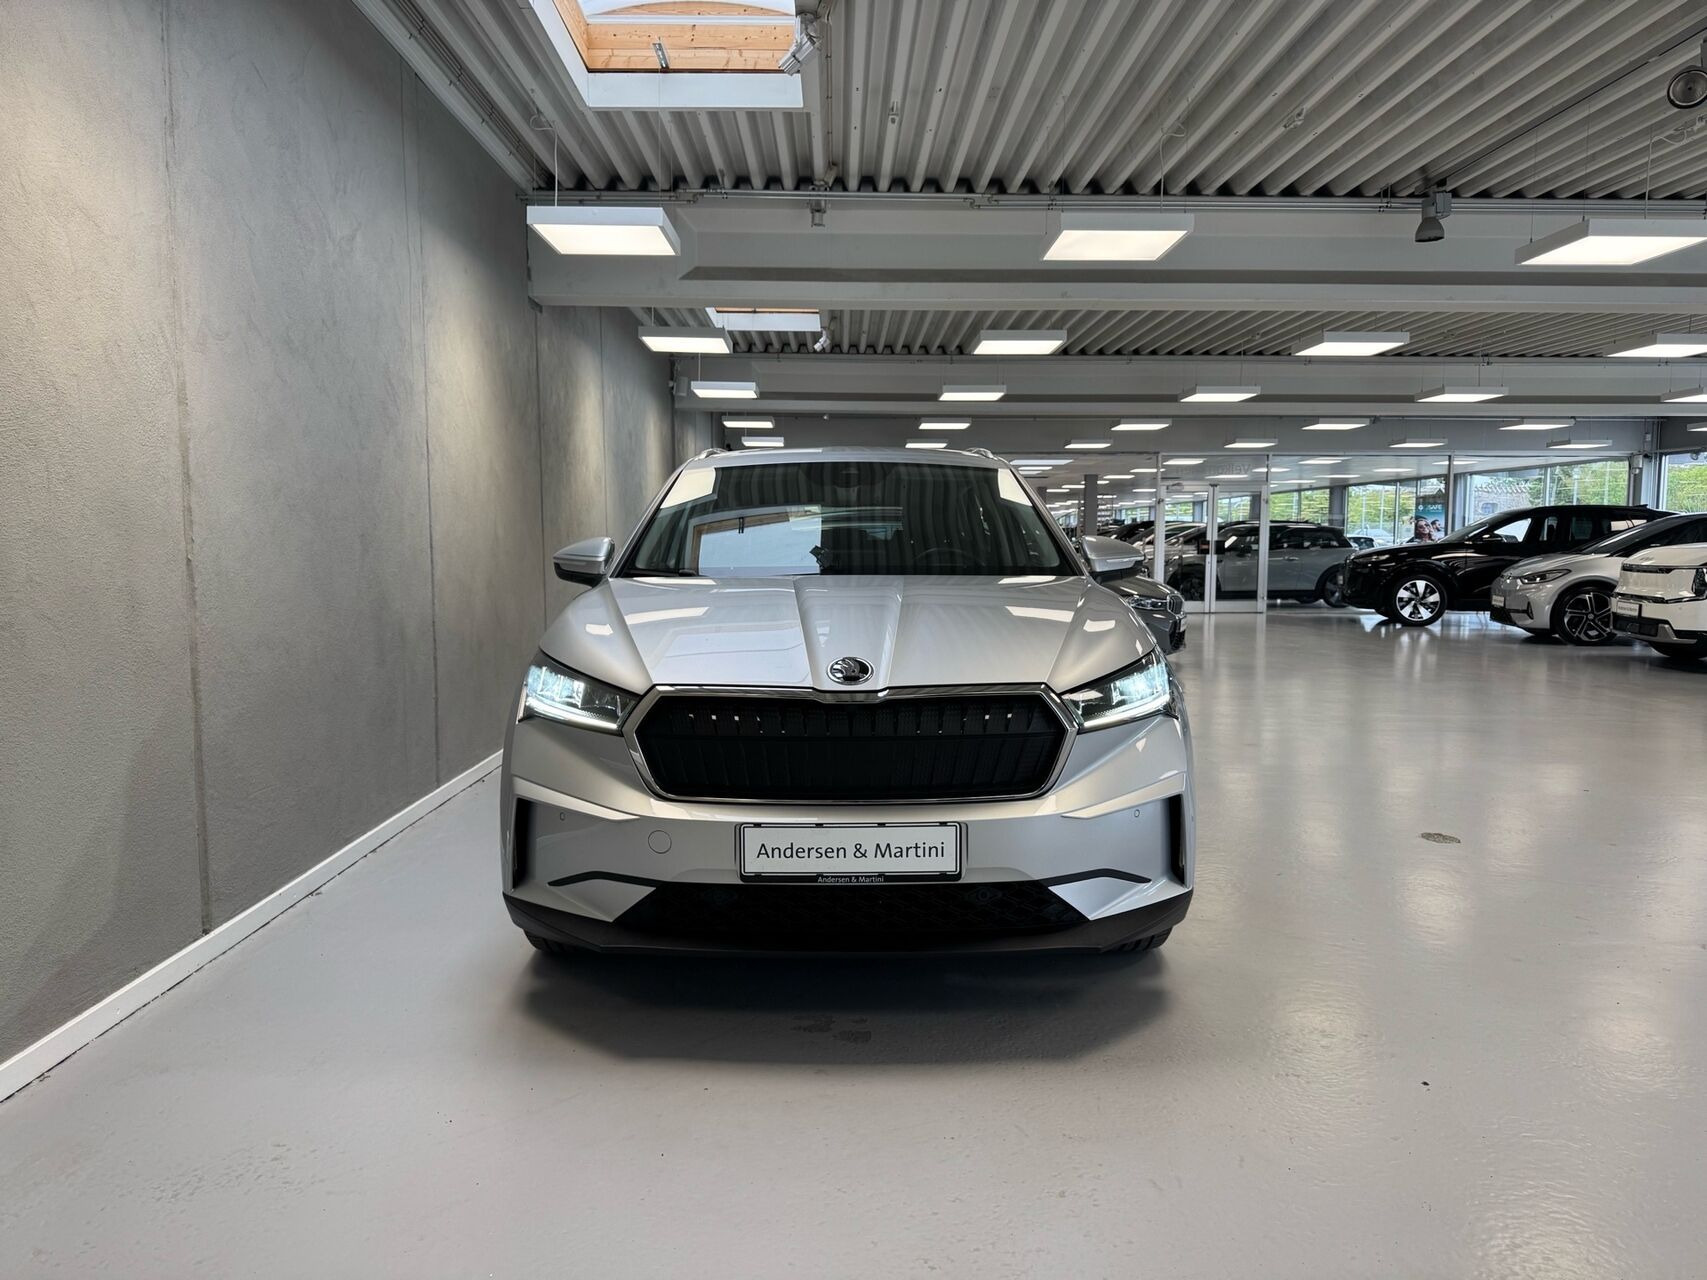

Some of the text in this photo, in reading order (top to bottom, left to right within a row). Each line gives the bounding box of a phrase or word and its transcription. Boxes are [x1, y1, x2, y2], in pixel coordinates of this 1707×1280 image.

[756, 841, 945, 859] Andersen & Martini
